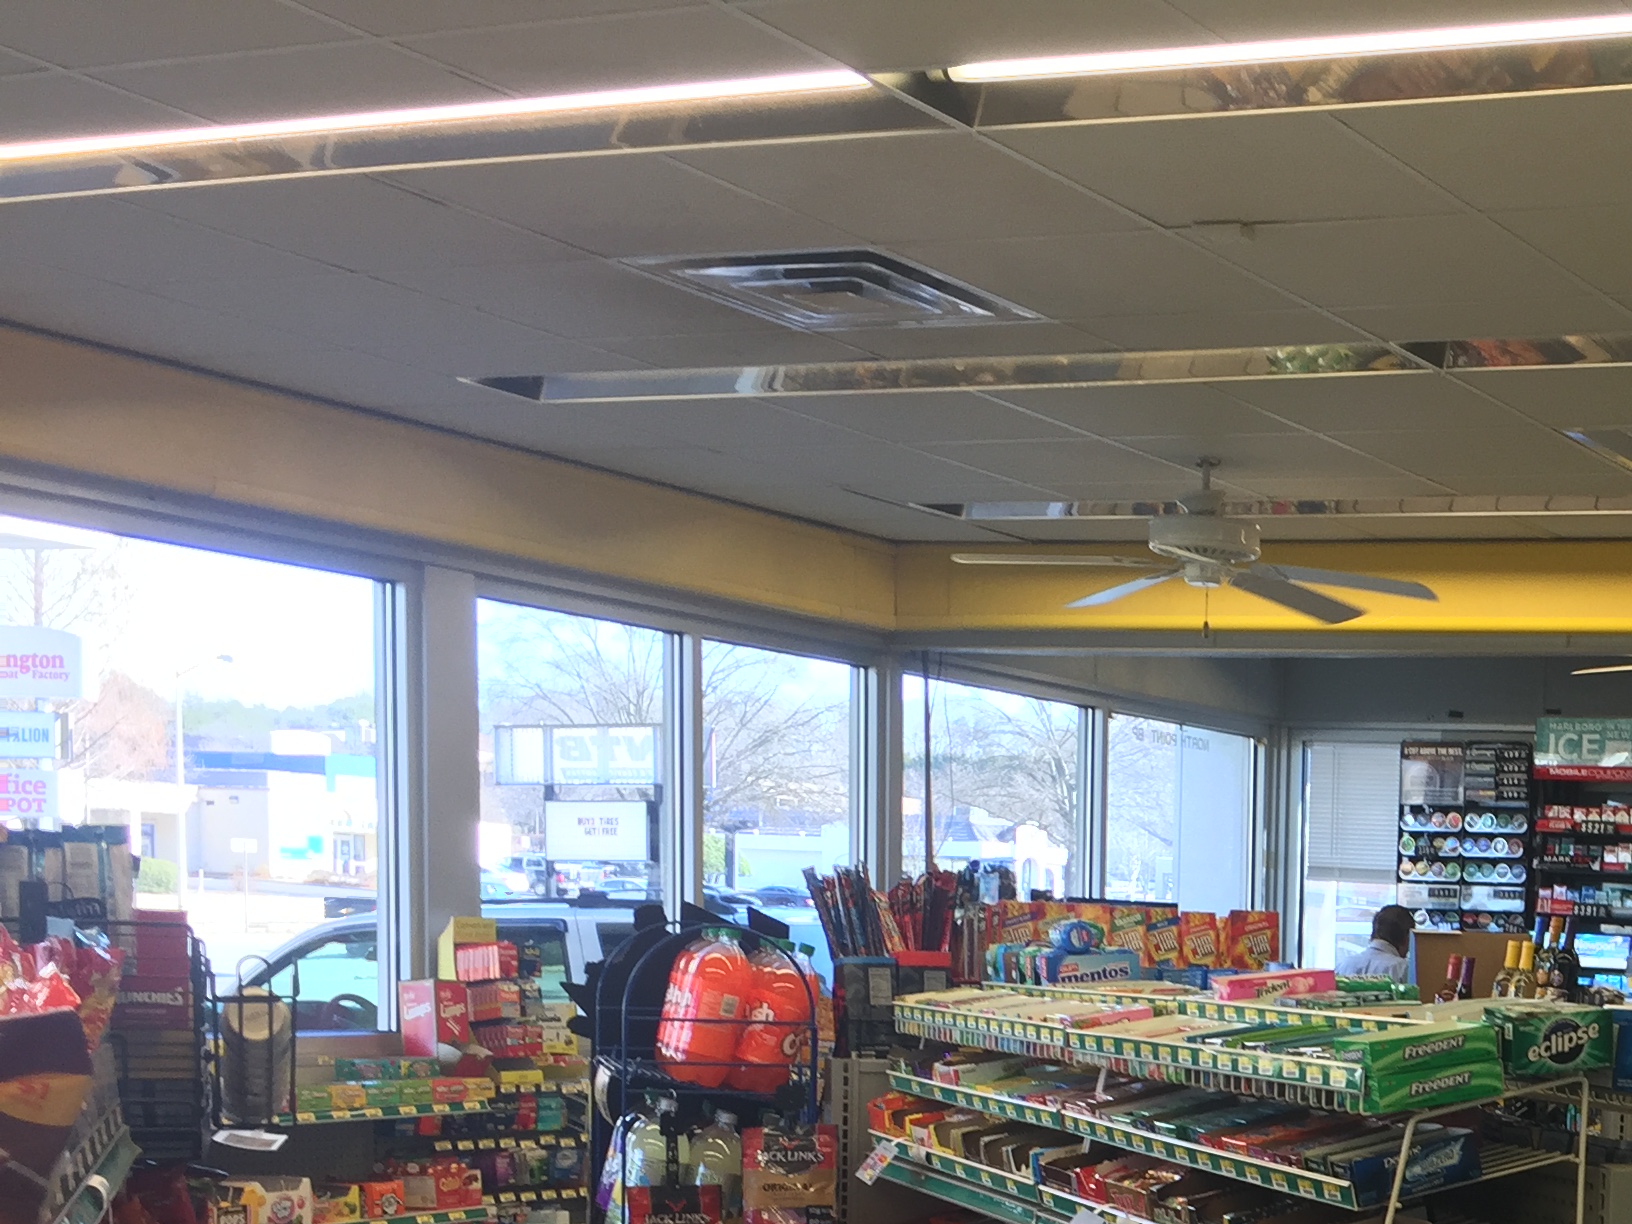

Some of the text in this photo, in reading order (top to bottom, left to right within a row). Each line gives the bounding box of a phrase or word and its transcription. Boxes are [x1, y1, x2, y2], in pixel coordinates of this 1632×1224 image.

[0, 653, 64, 674] ngton
[1549, 733, 1600, 761] ICE
[1527, 1021, 1600, 1062] eclipse
